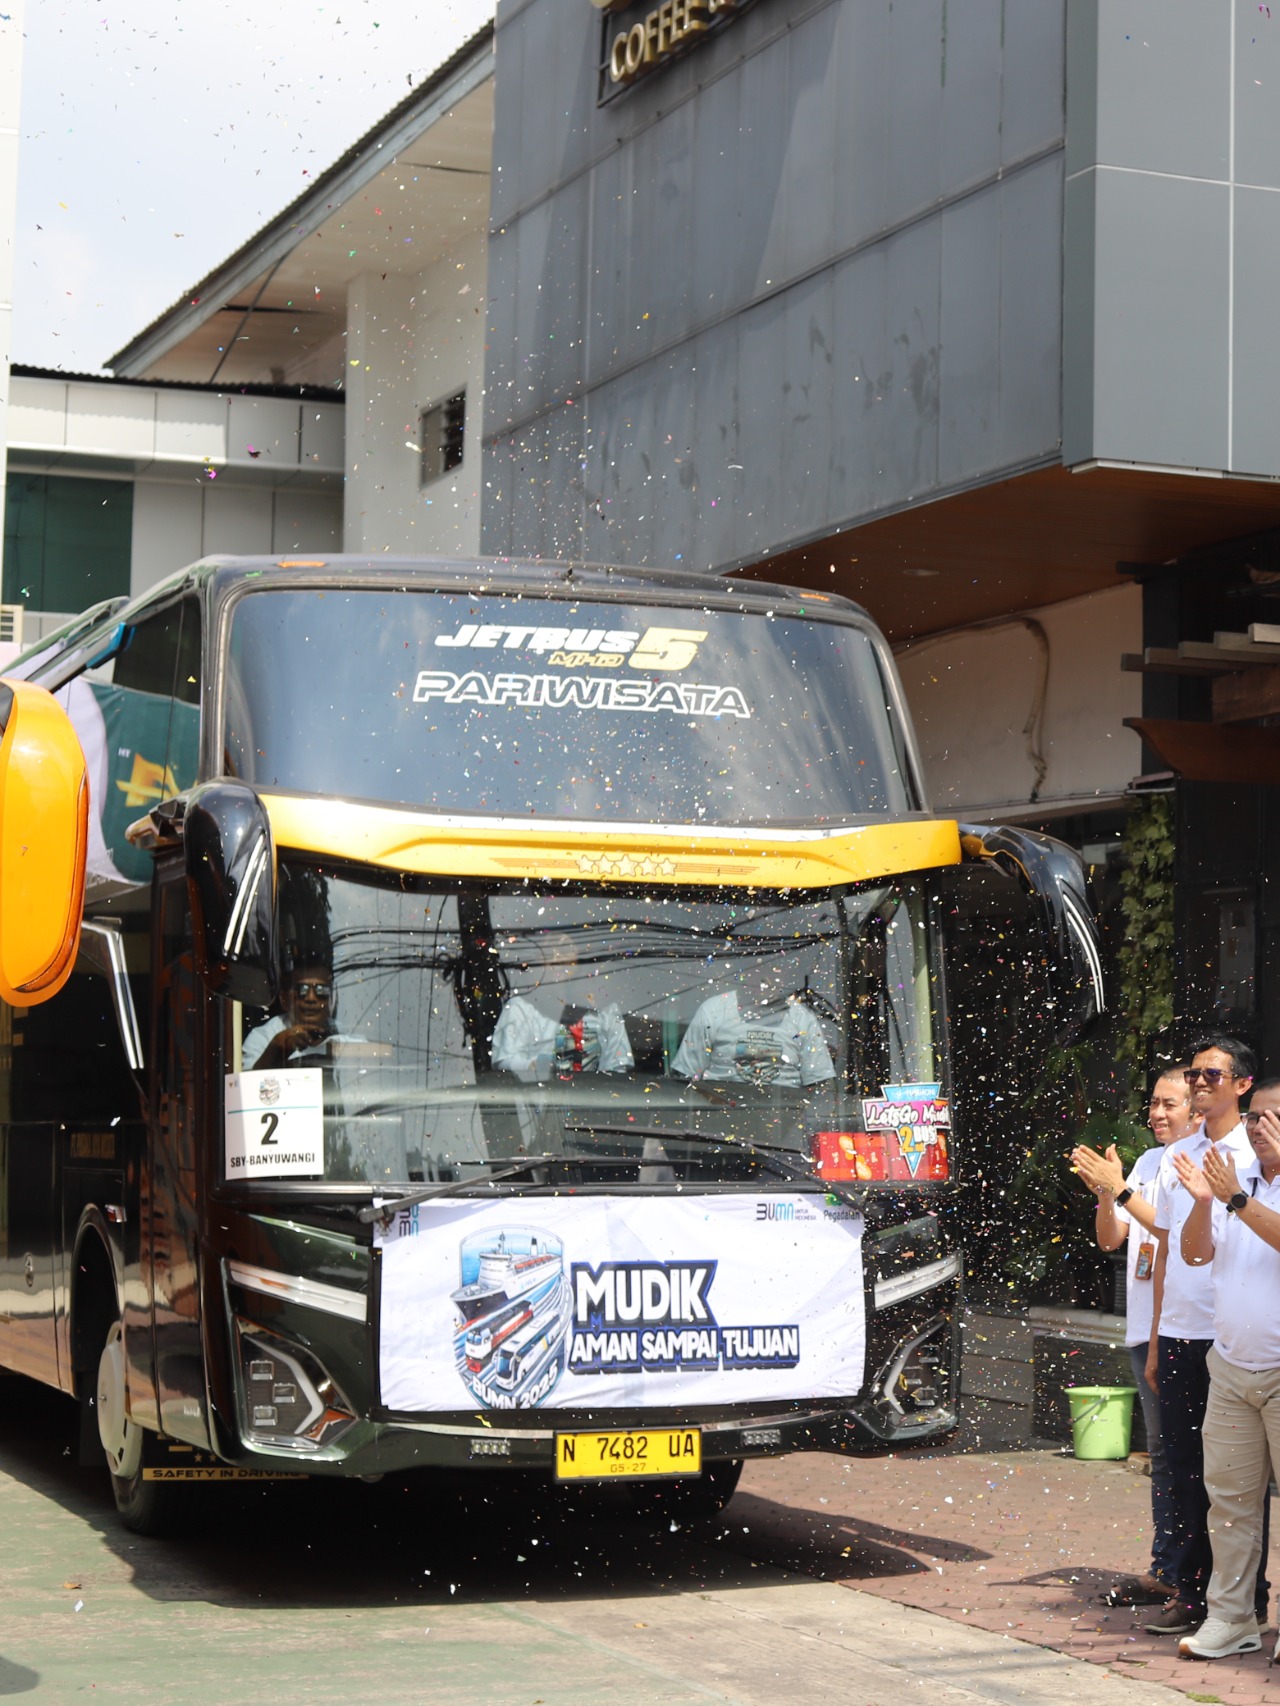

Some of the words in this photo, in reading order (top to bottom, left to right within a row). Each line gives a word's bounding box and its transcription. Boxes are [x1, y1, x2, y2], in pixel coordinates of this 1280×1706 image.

[434, 624, 640, 653] JETBUS
[628, 627, 708, 671] 5
[413, 671, 751, 718] PARIWISATA
[261, 1112, 280, 1146] 2
[230, 1153, 316, 1168] SBY-BANYUWANGI
[576, 1268, 708, 1323] MUDIK
[571, 1333, 637, 1362] AMAN
[641, 1331, 718, 1360] SAMPAI
[722, 1327, 798, 1358] TUJUAN
[472, 1375, 517, 1410] BUMN
[520, 1358, 558, 1409] 2025
[563, 1439, 575, 1462] N
[597, 1436, 648, 1460] 7482
[669, 1434, 694, 1457] UA
[153, 1469, 216, 1478] SAFETY
[220, 1469, 234, 1478] IN
